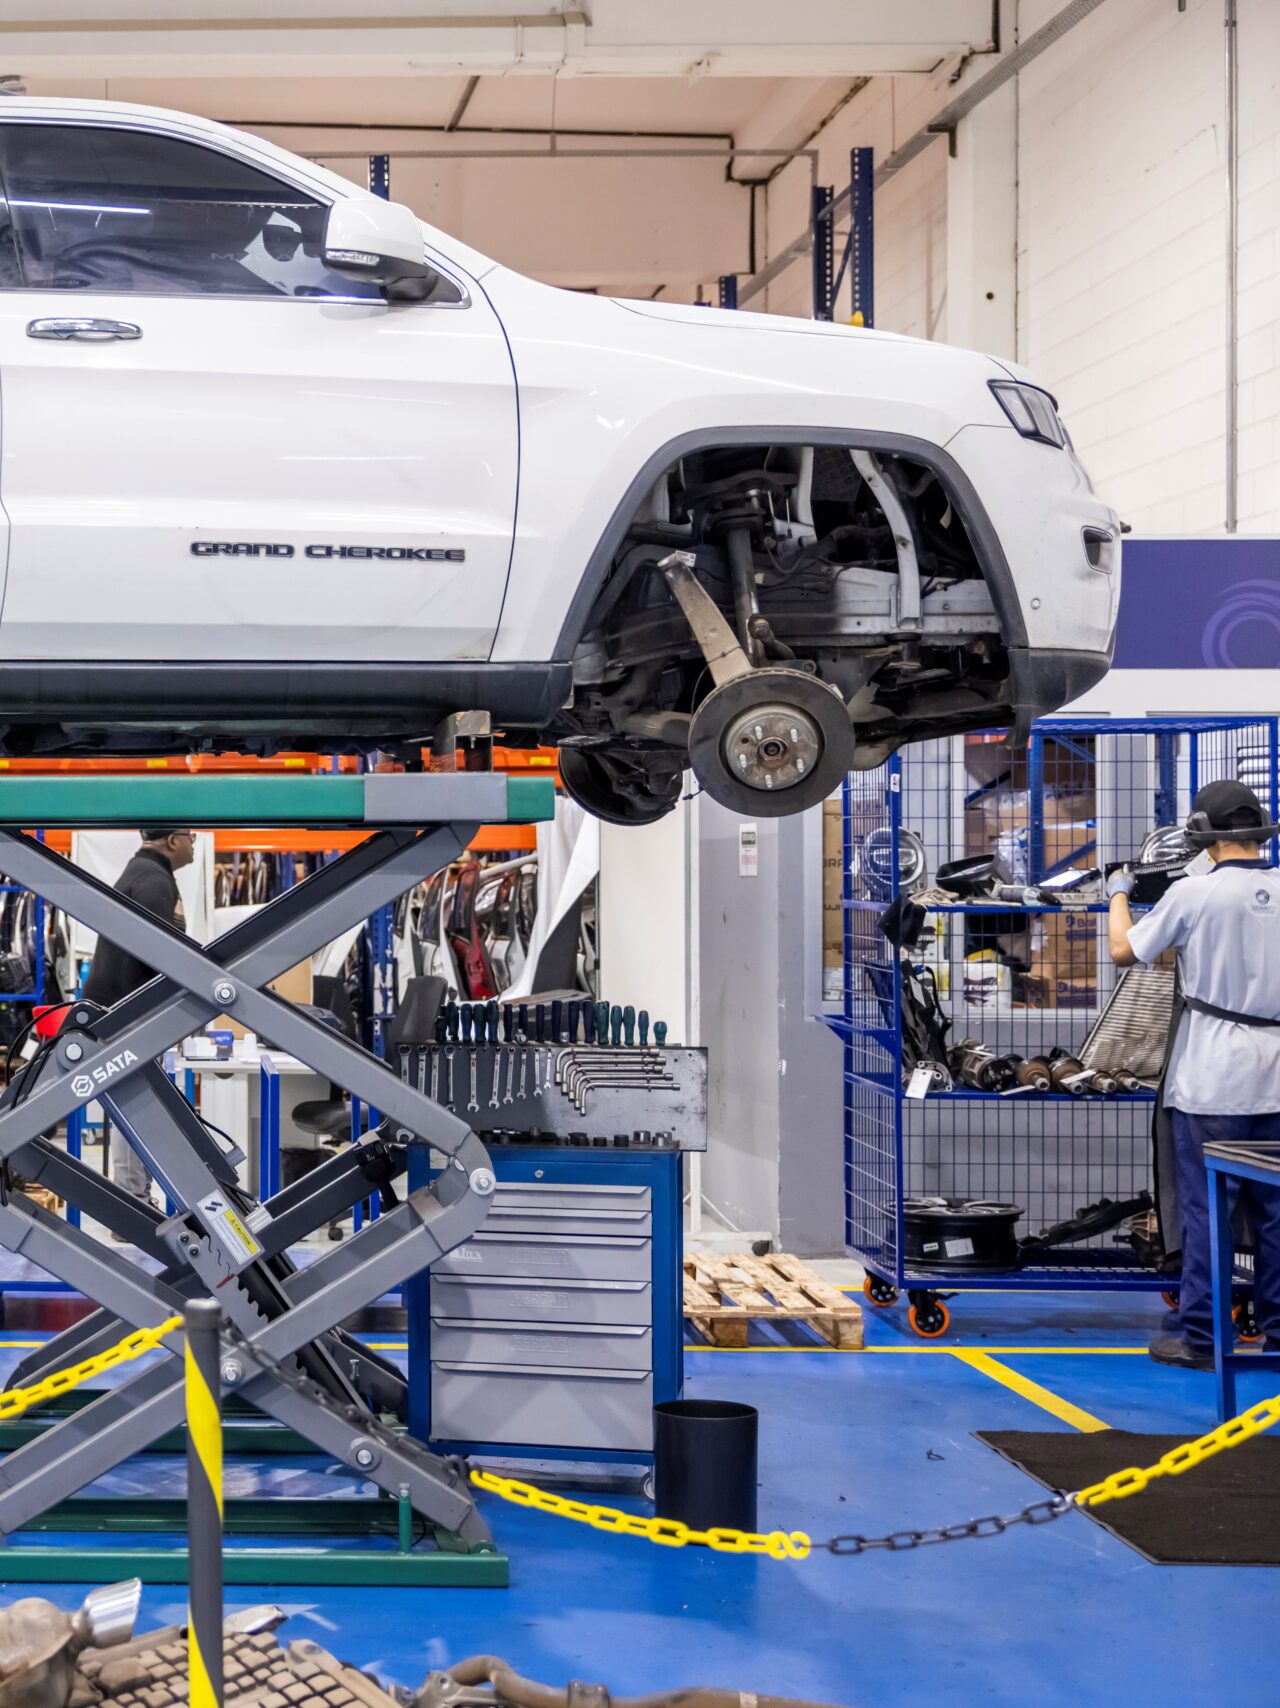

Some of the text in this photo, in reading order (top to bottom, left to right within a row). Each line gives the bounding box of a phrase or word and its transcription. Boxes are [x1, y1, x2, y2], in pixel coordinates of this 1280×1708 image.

[190, 541, 466, 563] GRAND CHEROKEE
[92, 1049, 139, 1084] SATA
[234, 1223, 253, 1246] CAUTION
